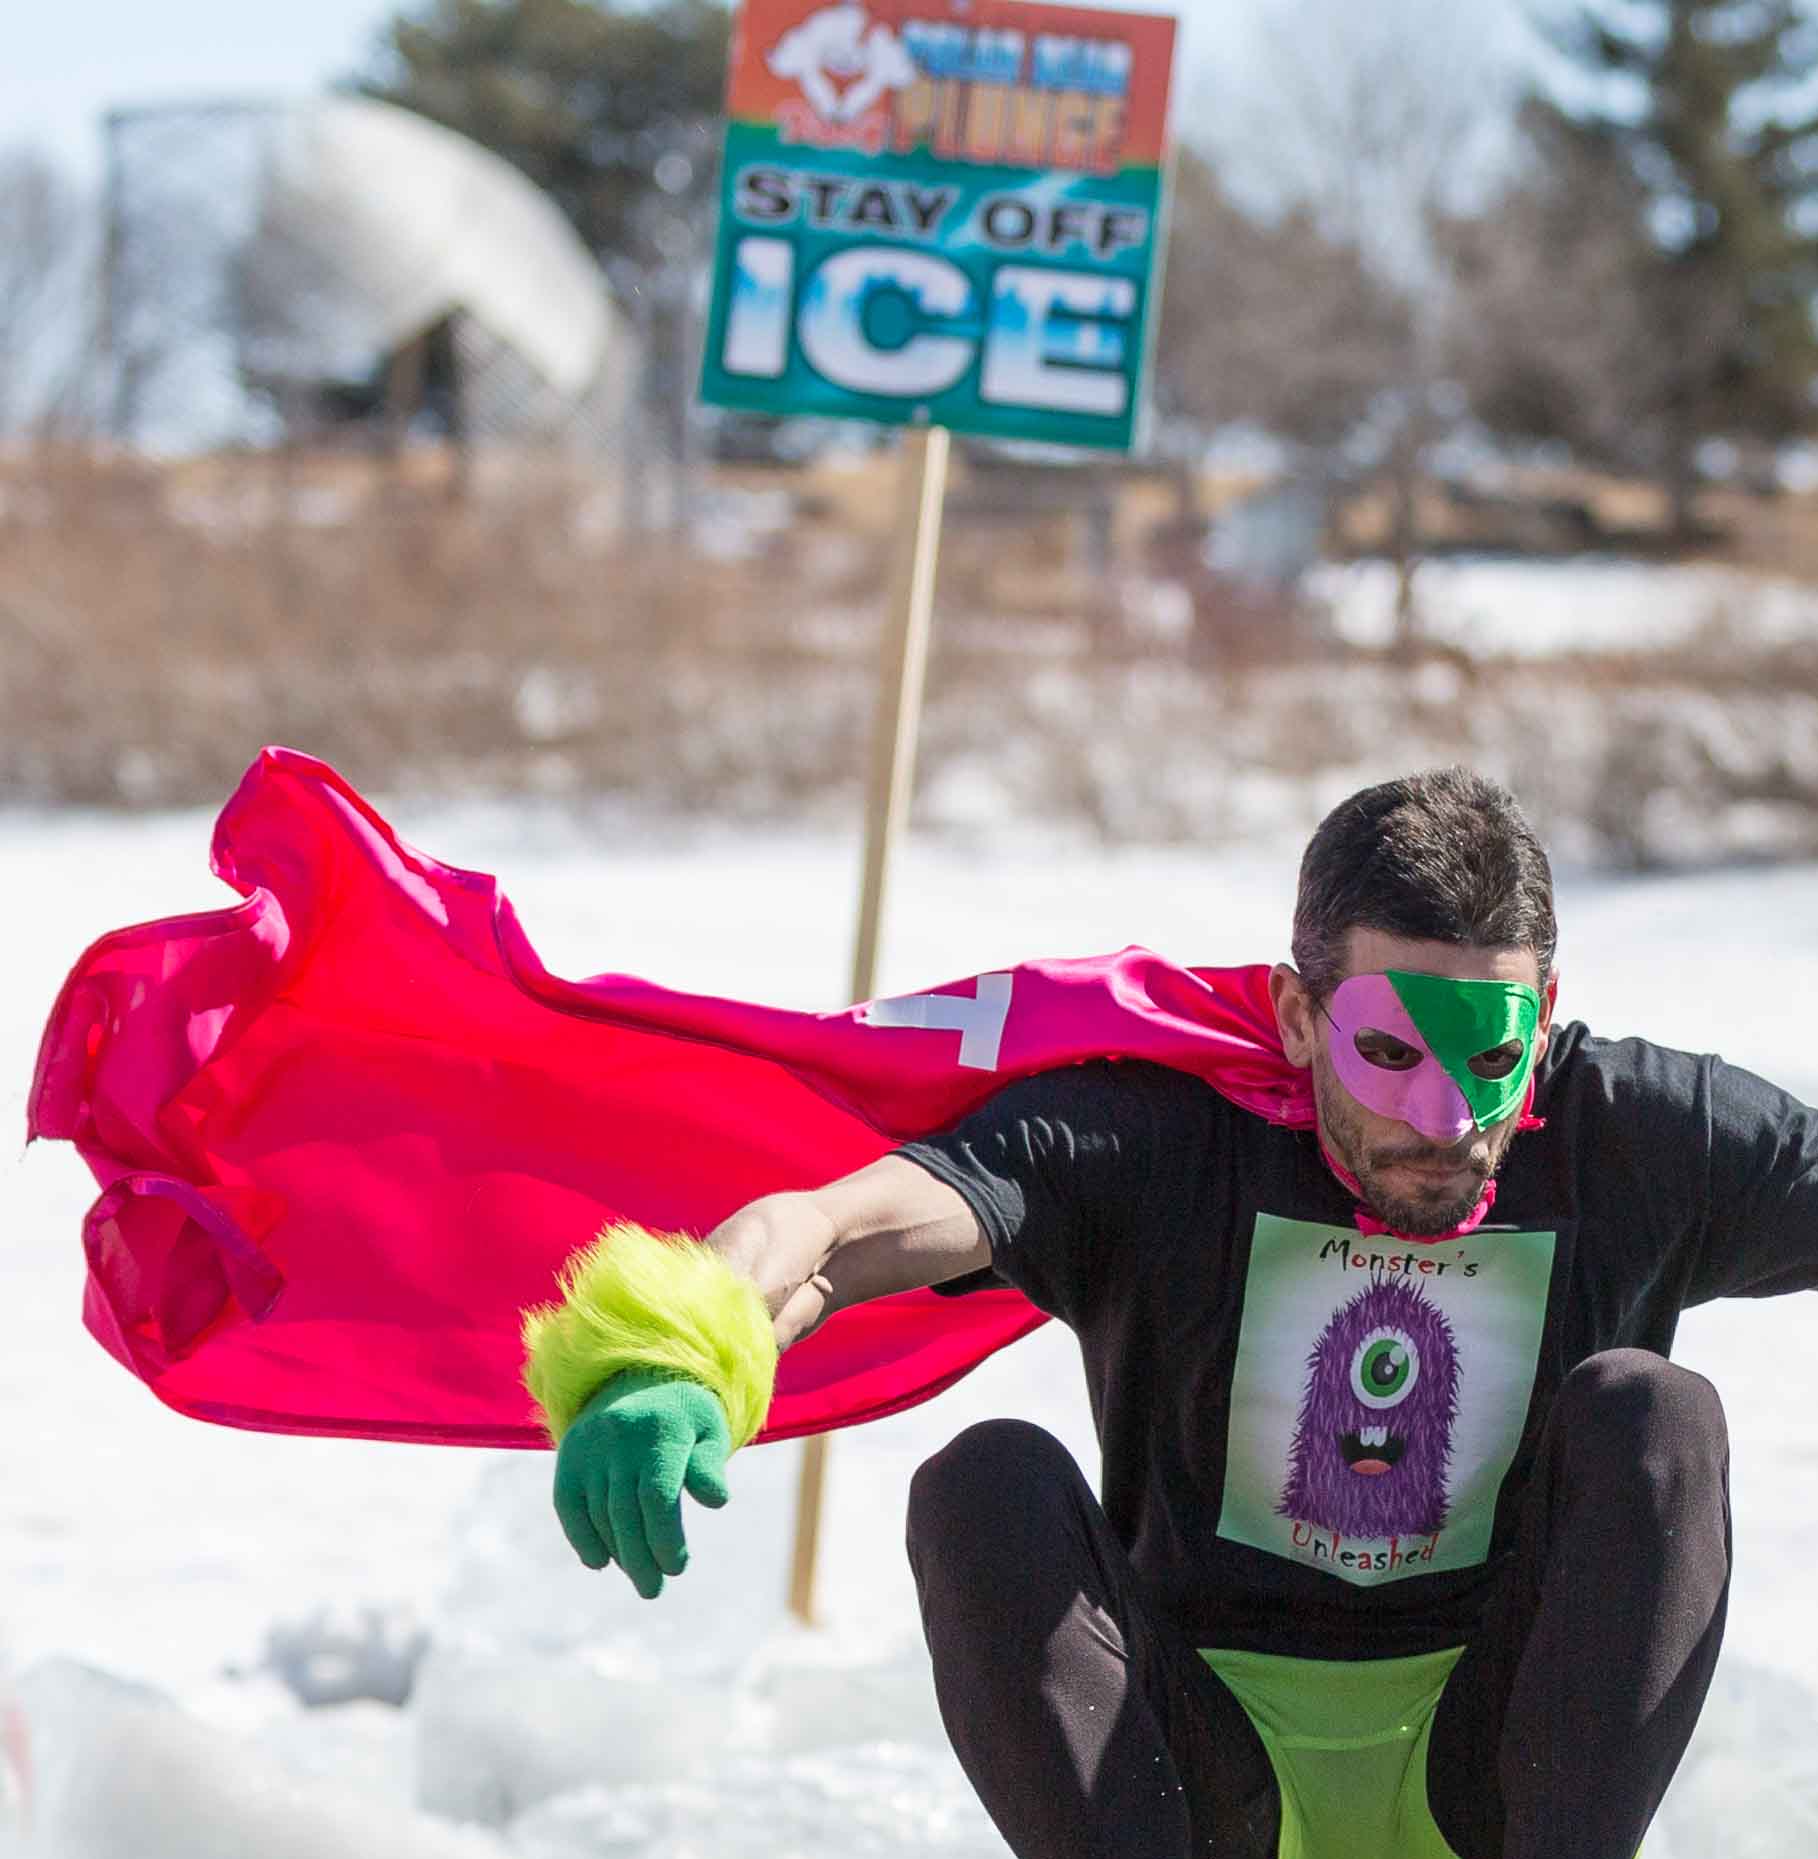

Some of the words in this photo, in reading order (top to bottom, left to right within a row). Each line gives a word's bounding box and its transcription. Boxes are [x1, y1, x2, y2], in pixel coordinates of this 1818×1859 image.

[738, 167, 956, 237] STAY
[980, 193, 1148, 259] OFF
[722, 235, 1136, 418] ICE
[1319, 1238, 1480, 1278] Monster's
[1292, 1520, 1438, 1571] Unleashed
